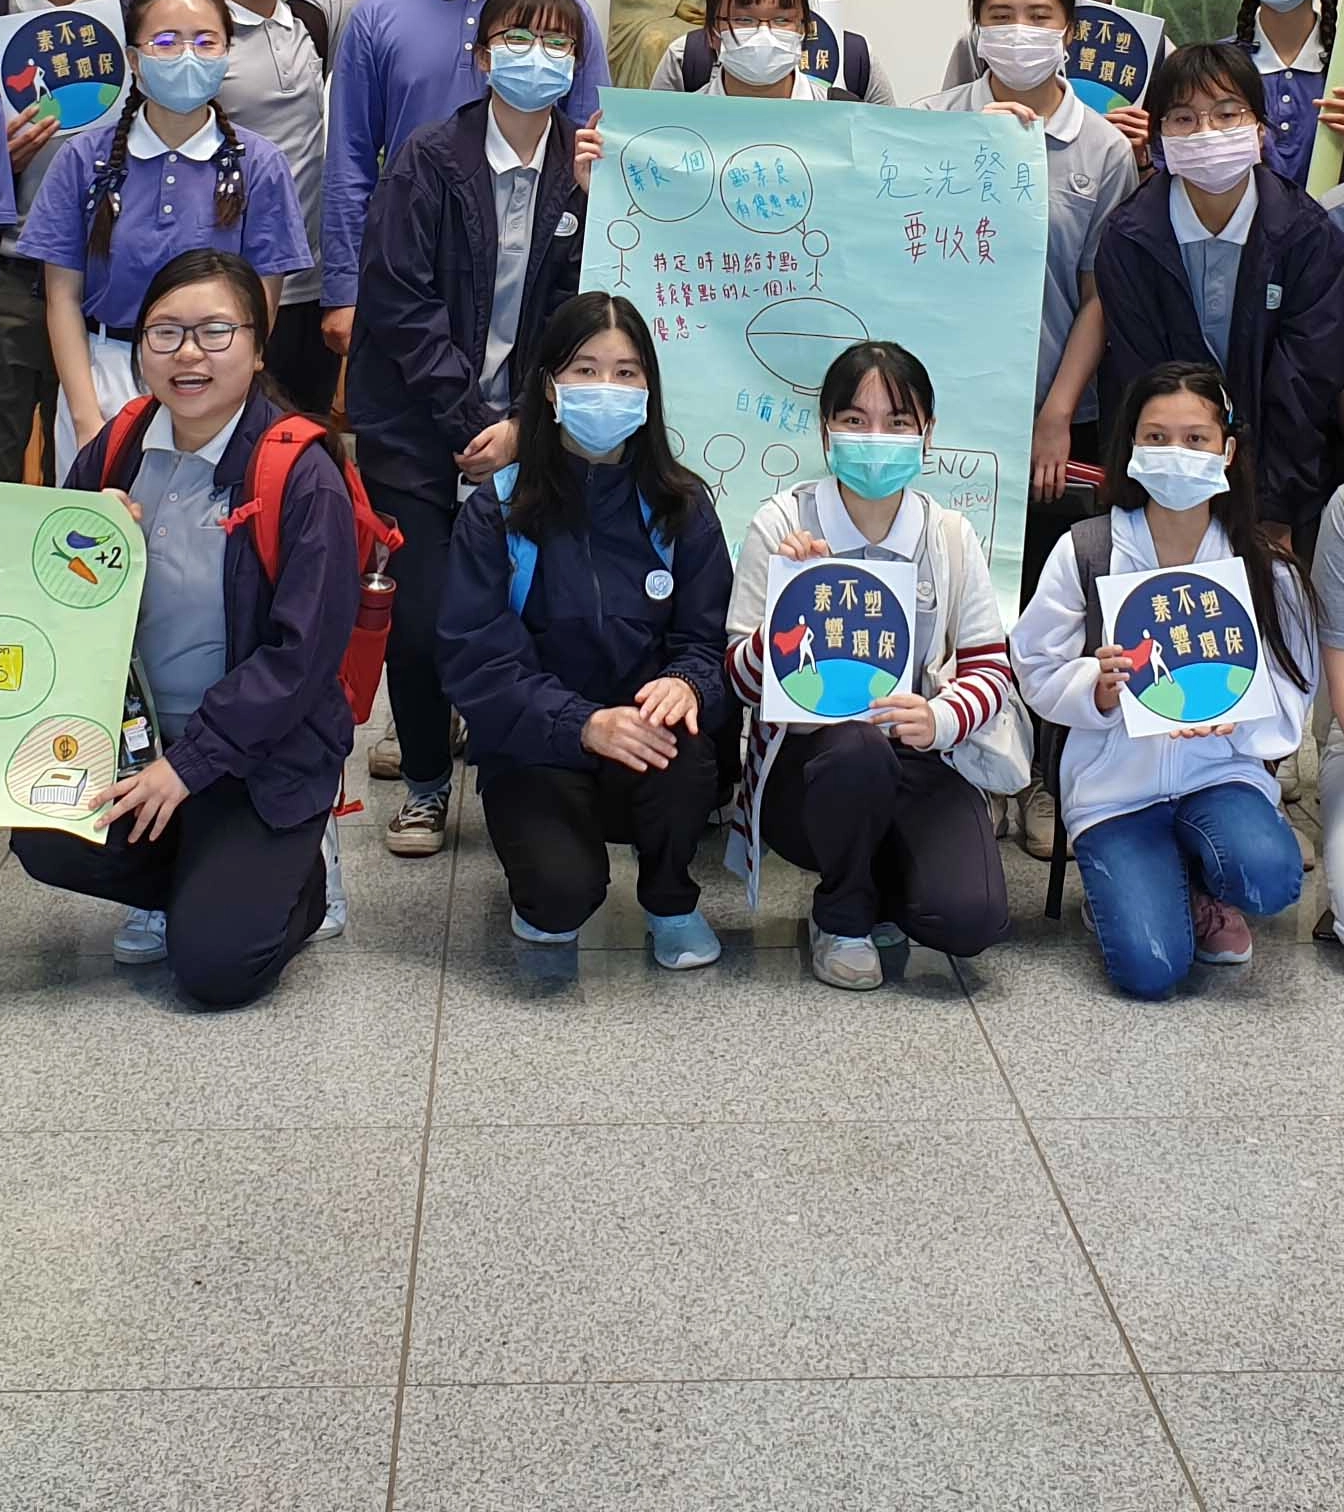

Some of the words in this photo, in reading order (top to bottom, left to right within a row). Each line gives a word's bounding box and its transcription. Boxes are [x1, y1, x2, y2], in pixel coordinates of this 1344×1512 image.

[36, 20, 99, 53] 素不塑
[1073, 19, 1133, 54] 素不塑
[51, 52, 115, 80] 響環保
[800, 49, 830, 71] 環保
[1078, 46, 1137, 88] 響環保
[876, 144, 1036, 205] 免洗餐具
[903, 211, 997, 265] 要收費
[653, 250, 798, 273] 特定時期給予點
[736, 388, 811, 436] 自備餐具
[921, 452, 980, 479] ENU
[953, 492, 991, 508] NEW
[94, 546, 123, 569] +2
[814, 579, 883, 617] 素不塑
[1151, 584, 1223, 623] 素不塑
[824, 617, 896, 660] 響環保
[1169, 624, 1244, 658] 響環保
